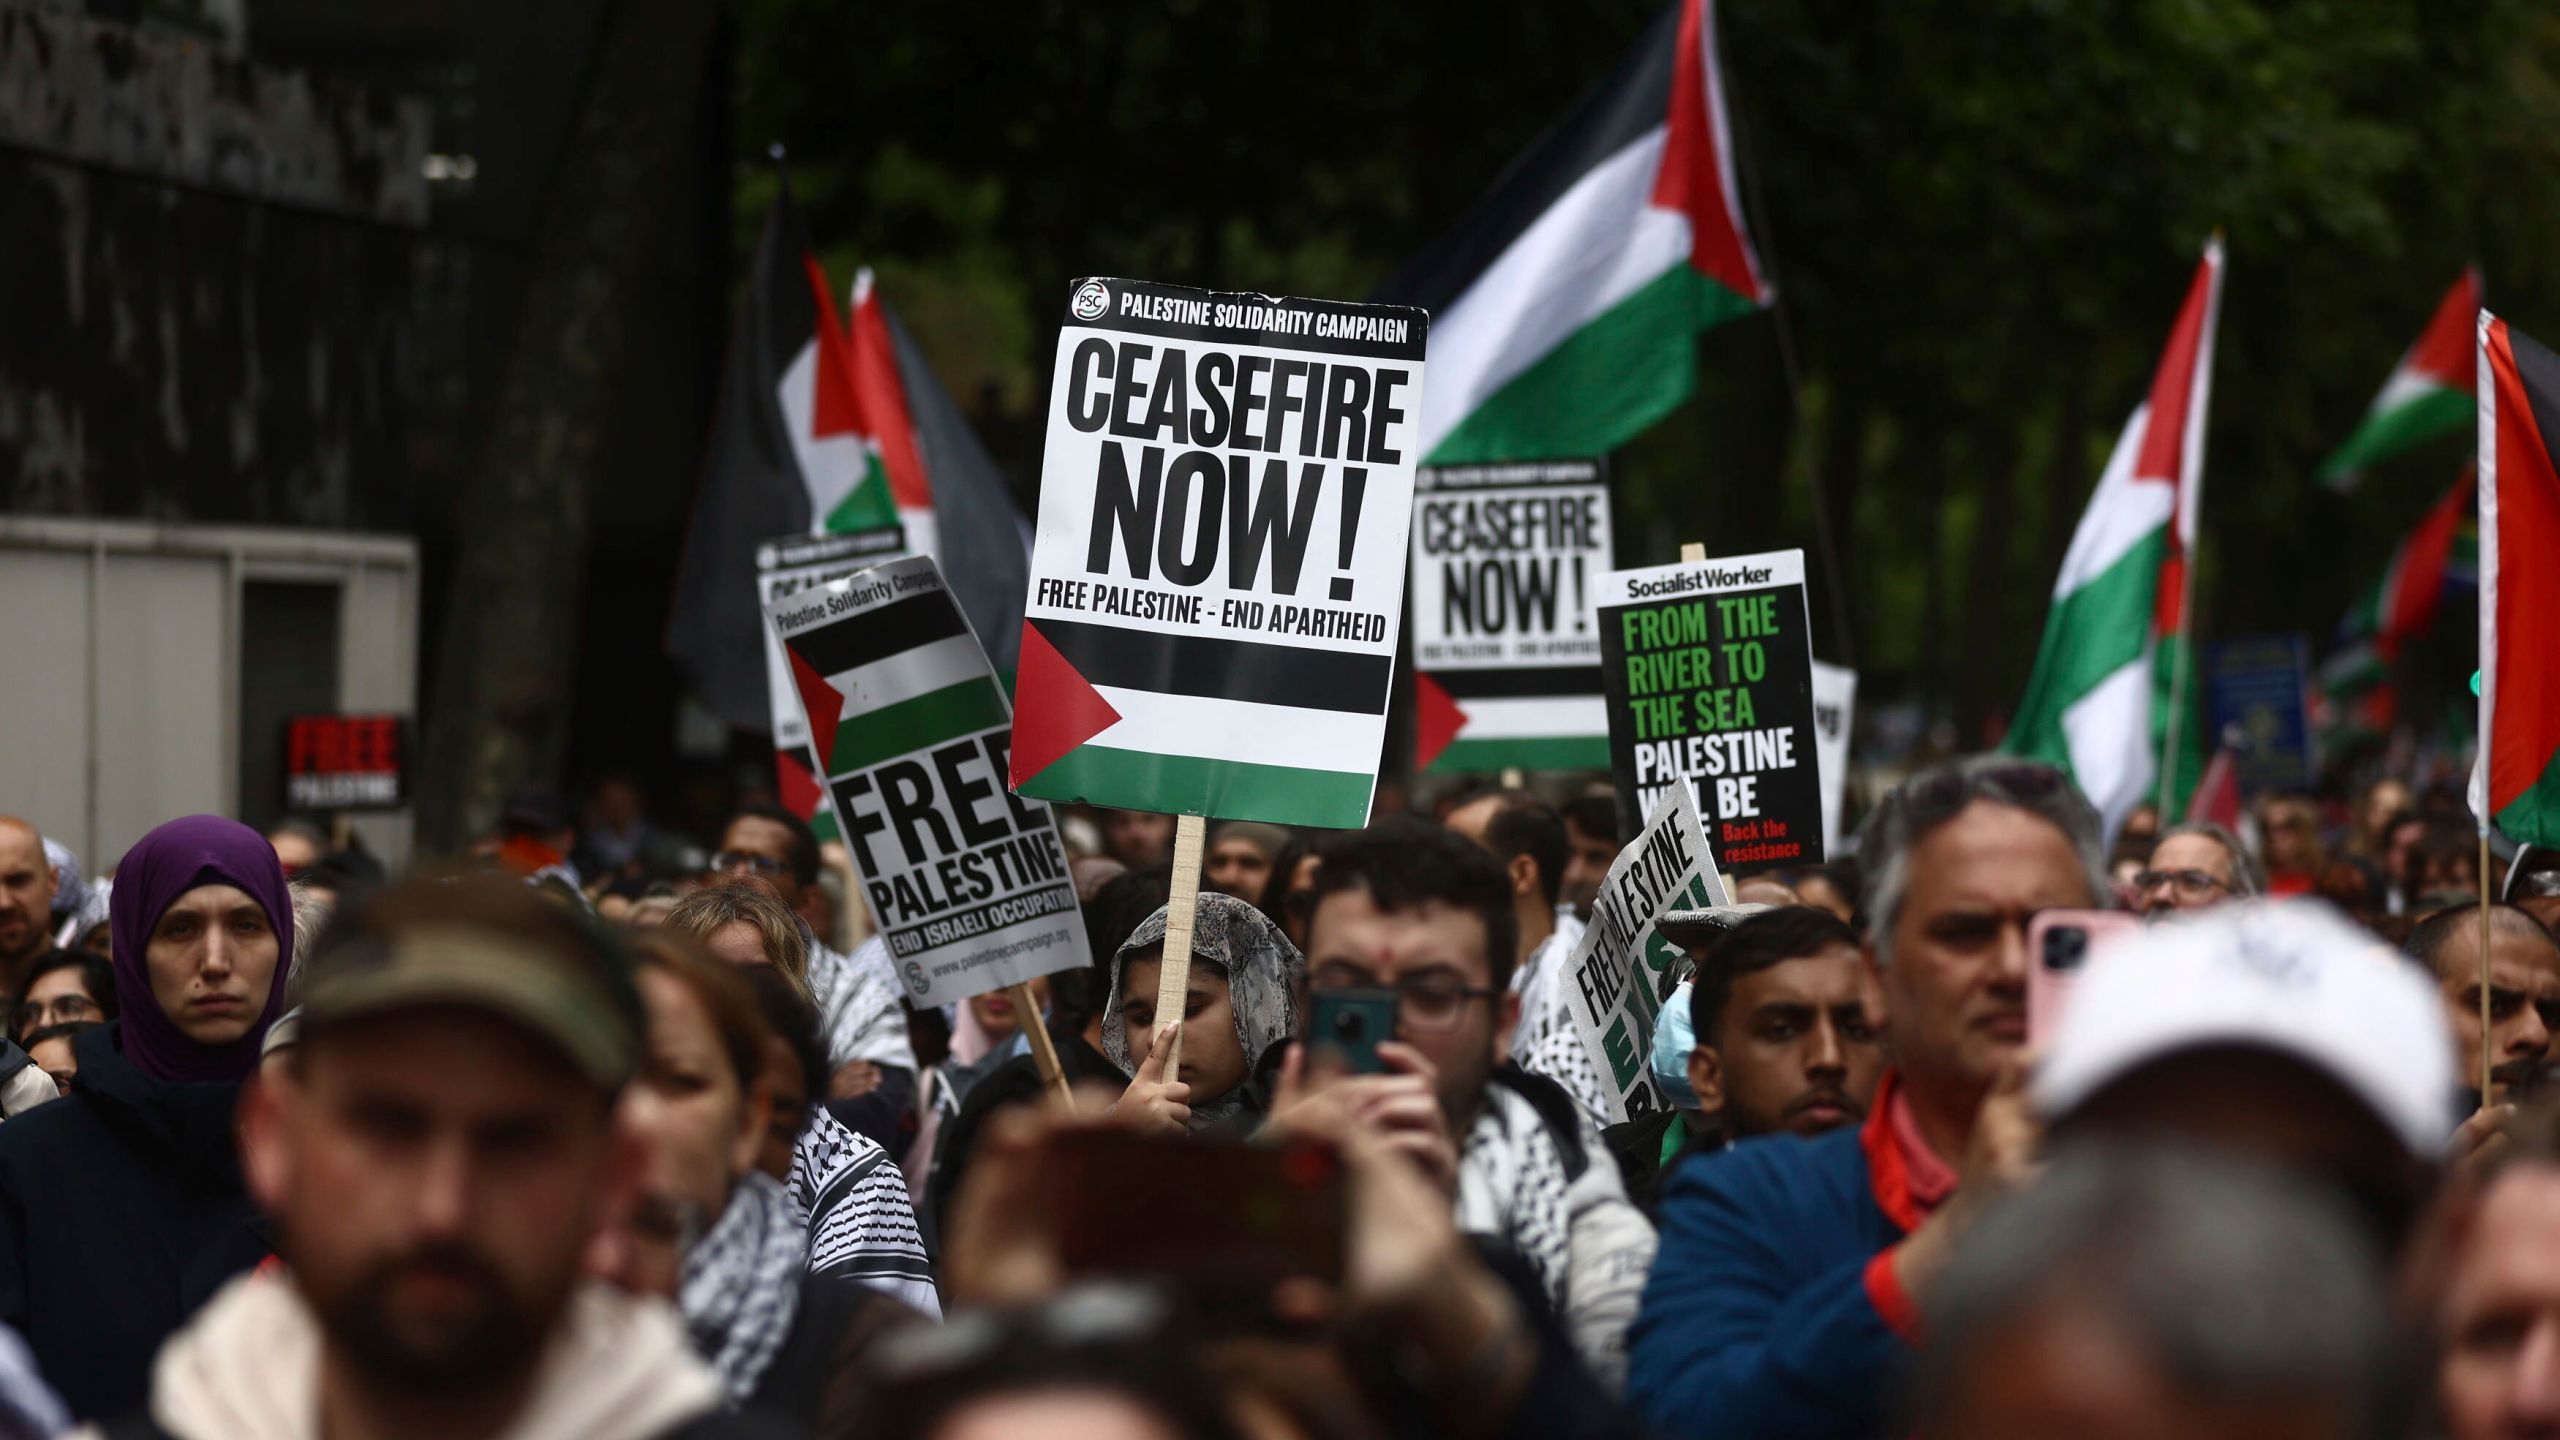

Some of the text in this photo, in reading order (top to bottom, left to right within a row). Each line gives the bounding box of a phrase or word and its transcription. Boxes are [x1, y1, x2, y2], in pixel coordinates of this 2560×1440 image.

[1078, 294, 1102, 308] PSC
[1120, 292, 1408, 344] PALESTINE SOLIDARITY CAMPAIGN
[1066, 338, 1409, 465] CEASEFIRE
[1086, 440, 1368, 602] NOW!
[1424, 496, 1599, 555] CEASEFIRE
[776, 607, 826, 632] Palestine
[826, 581, 892, 616] Solidarity
[1444, 557, 1587, 635] NOW!
[1628, 566, 1772, 598] Socialist Worker
[1037, 578, 1088, 610] FREE
[1092, 584, 1203, 624] PALESTINE
[1221, 599, 1264, 630] END
[1268, 604, 1386, 643] APARTHEID
[1622, 595, 1779, 651] FROM THE
[1626, 642, 1765, 696] RIVER TO
[1629, 688, 1755, 739] THE SEA
[1634, 727, 1796, 784] PALESTINE
[1716, 776, 1759, 819] BE
[1723, 822, 1760, 842] Back
[1763, 818, 1787, 838] the
[1724, 841, 1801, 864] resistance
[868, 831, 1067, 926] PALESTINE
[892, 930, 923, 955] END
[923, 912, 989, 946] ISRAELI
[1576, 927, 1624, 1028] FREE
